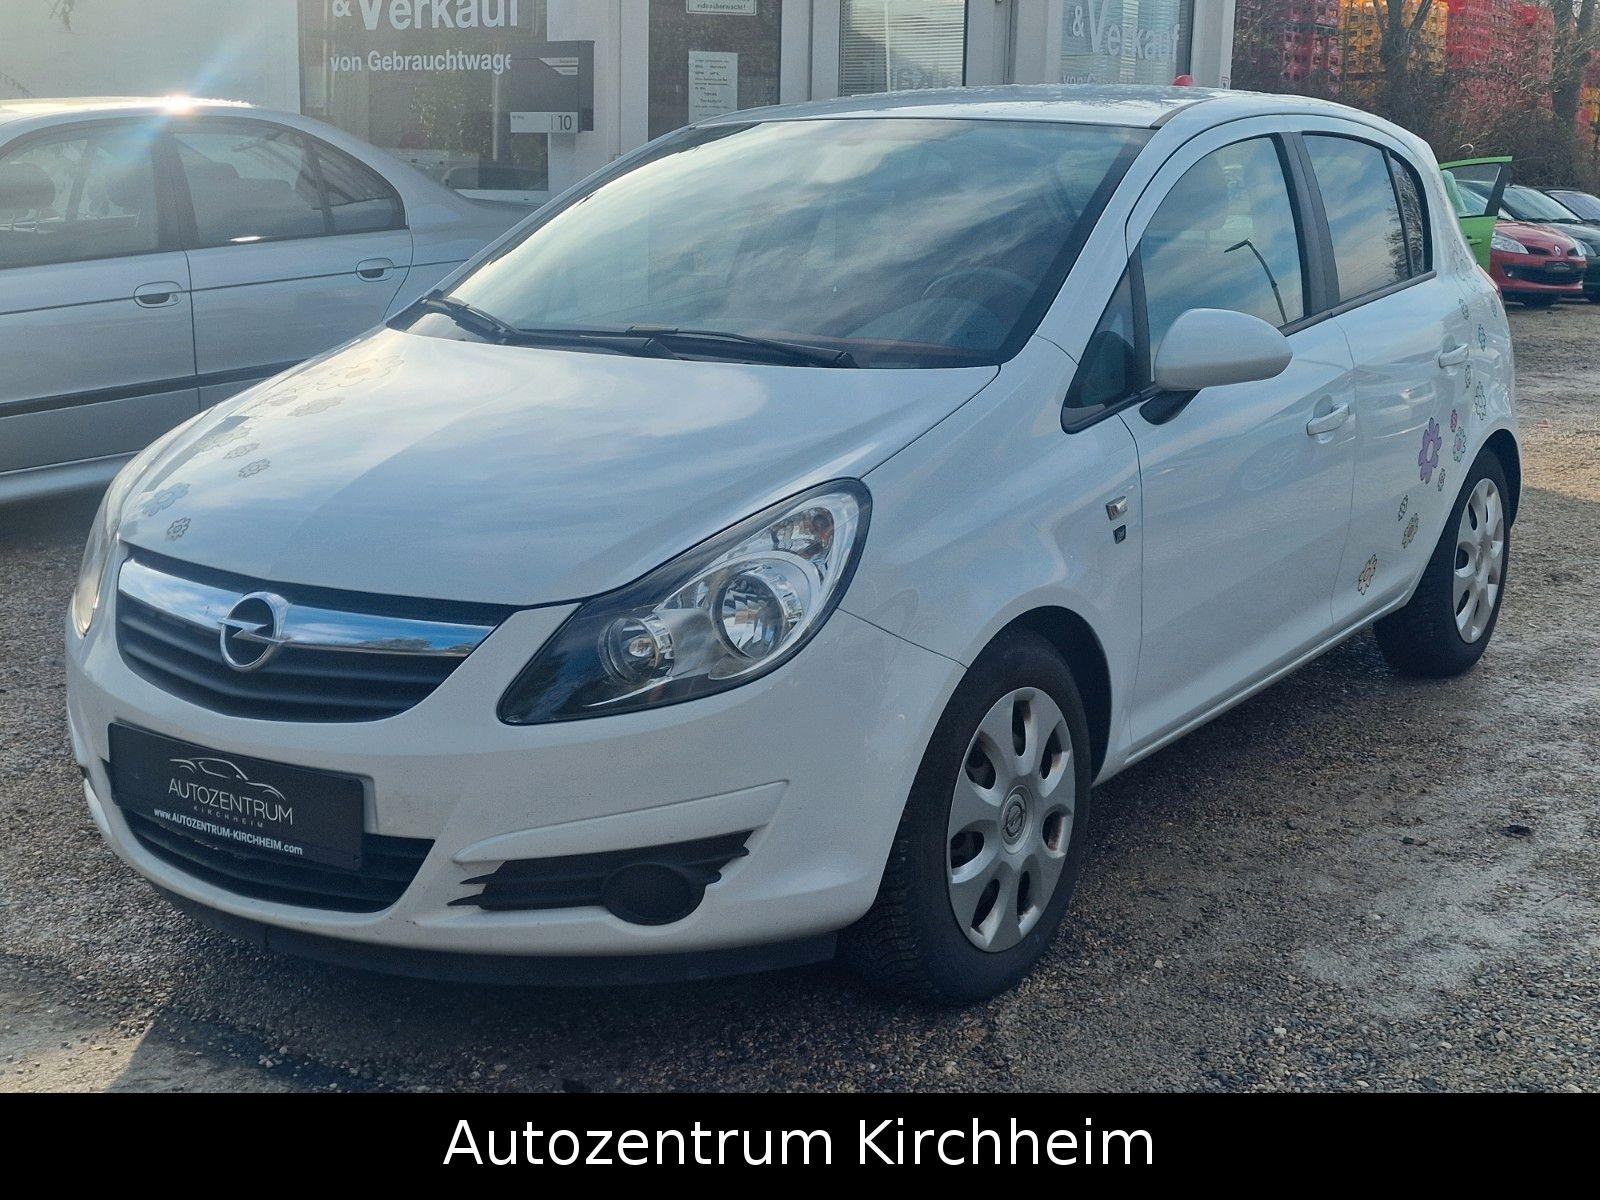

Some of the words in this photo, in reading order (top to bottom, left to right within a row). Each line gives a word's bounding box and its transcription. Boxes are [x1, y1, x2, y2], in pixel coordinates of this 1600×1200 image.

[1072, 5, 1085, 37] &
[328, 54, 362, 72] von
[558, 114, 572, 131] 10
[168, 777, 294, 826] AUTOZENTRUM
[193, 805, 264, 828] KIRCHHEIM
[153, 807, 303, 856] www.AUTOZENTRUM-KIRCHHEIM.com
